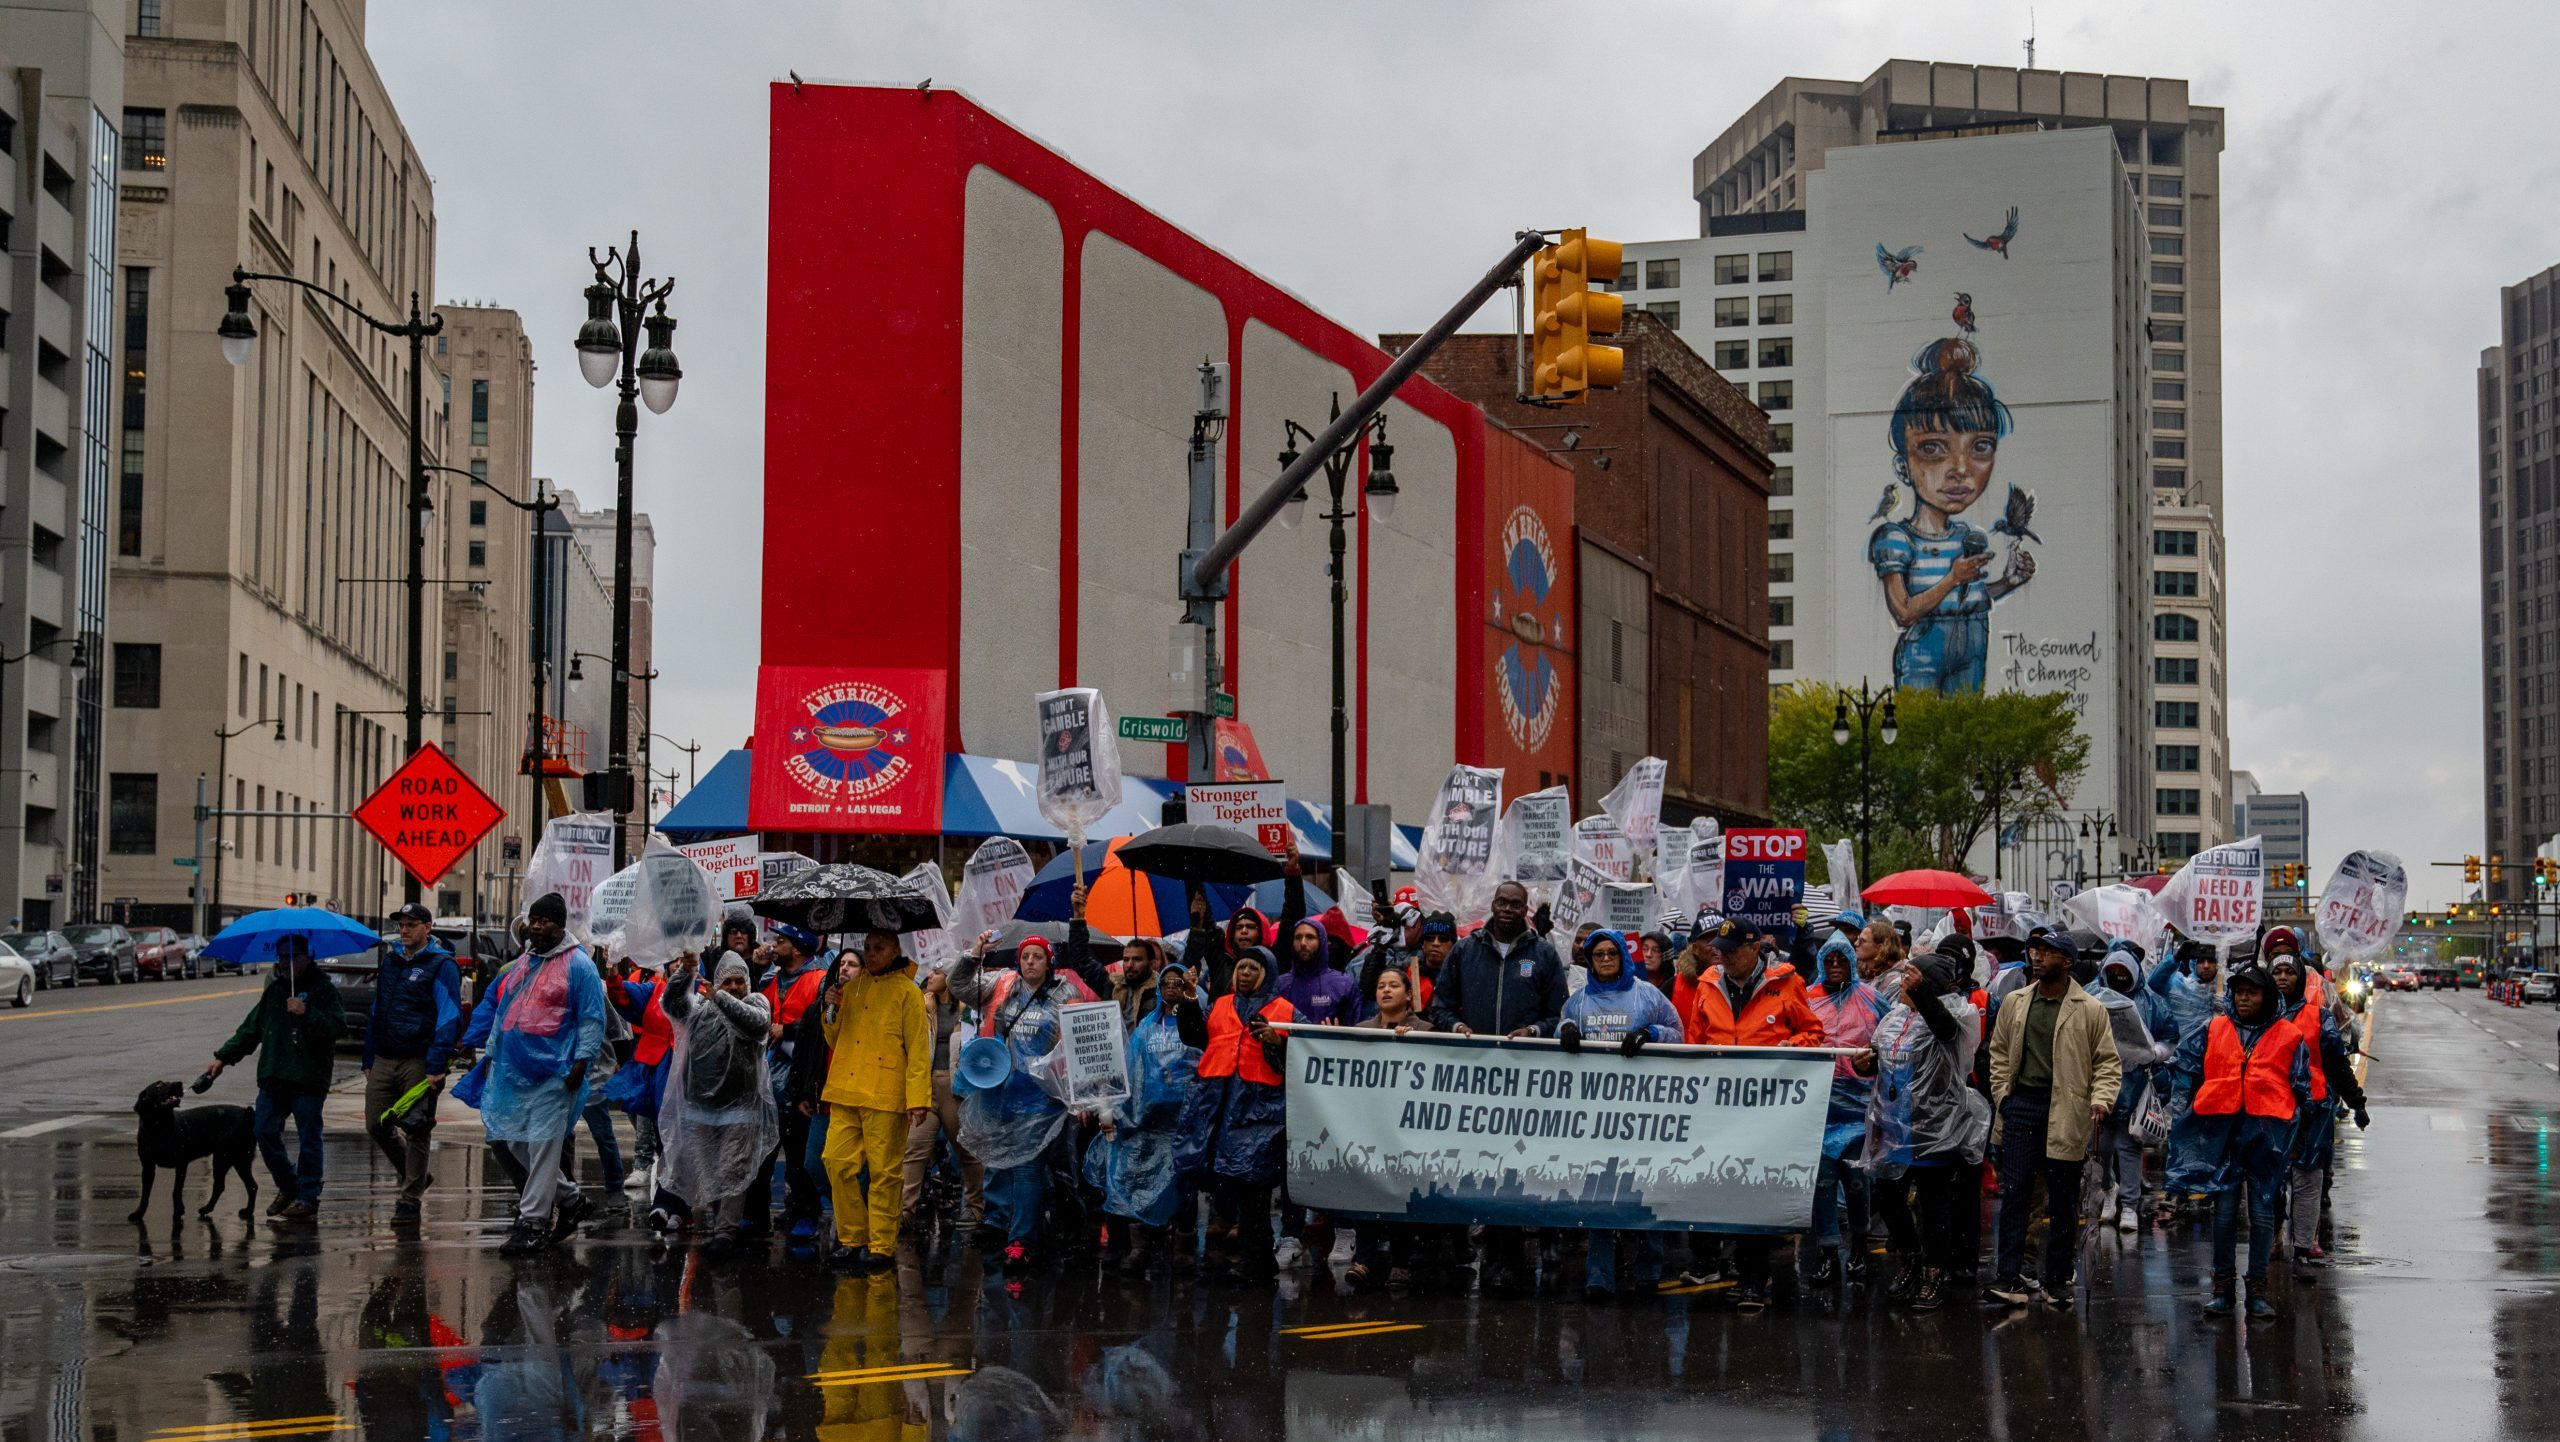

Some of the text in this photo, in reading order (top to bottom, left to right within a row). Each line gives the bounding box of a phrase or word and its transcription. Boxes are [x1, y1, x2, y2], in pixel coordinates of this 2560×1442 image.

[1504, 515, 1556, 588] AMERICAN
[2003, 631, 2100, 662] The sound
[2006, 659, 2091, 691] of change
[806, 687, 902, 718] AMERICAN
[1049, 698, 1074, 715] DON'T
[1216, 699, 1234, 713] chigan
[1043, 711, 1086, 734] GAMBLE
[1121, 719, 1184, 738] Griswold
[1069, 750, 1088, 766] OUR
[790, 754, 907, 794] CONEY ISLAND
[400, 778, 458, 795] ROAD
[1190, 788, 1258, 805] Stronger
[1449, 788, 1493, 804] MBLE
[400, 804, 458, 821] WORK
[789, 803, 902, 815] DETROIT LAS VEGAS
[1213, 804, 1283, 823] Together
[558, 826, 607, 841] MOTORCITY
[1440, 824, 1489, 839] ITH OUR
[1524, 822, 1558, 830] WORKERS'
[396, 830, 467, 847] AHEAD
[1730, 835, 1802, 857] STOP
[680, 843, 737, 859] Stronger
[1437, 839, 1488, 857] UTURE
[1594, 842, 1614, 859] ON
[568, 859, 592, 883] ON
[698, 855, 757, 874] Together
[1758, 864, 1775, 875] THE
[602, 889, 623, 897] RIGHTS
[994, 872, 1017, 898] ON
[1740, 877, 1795, 898] WAR
[2199, 879, 2254, 897] NEED A
[1611, 898, 1632, 906] MARCH
[1758, 902, 1771, 911] ON
[2193, 898, 2257, 923] RAISE
[1557, 904, 1580, 923] FUT
[1610, 915, 1644, 923] RIGHTS AND
[1611, 923, 1642, 931] ECONOMIC
[1072, 1012, 1107, 1024] DETROIT'S
[1072, 1022, 1110, 1035] MARCH FOR
[1075, 1032, 1109, 1044] WORKERS'
[1075, 1043, 1113, 1055] RIGHTS AND
[1078, 1053, 1113, 1065] ECONOMIC
[1304, 1056, 1808, 1107] DETROIT'S MARCH FOR WORKERS' RIGHTS
[1398, 1100, 1692, 1143] AND ECONOMIC JUSTICE
